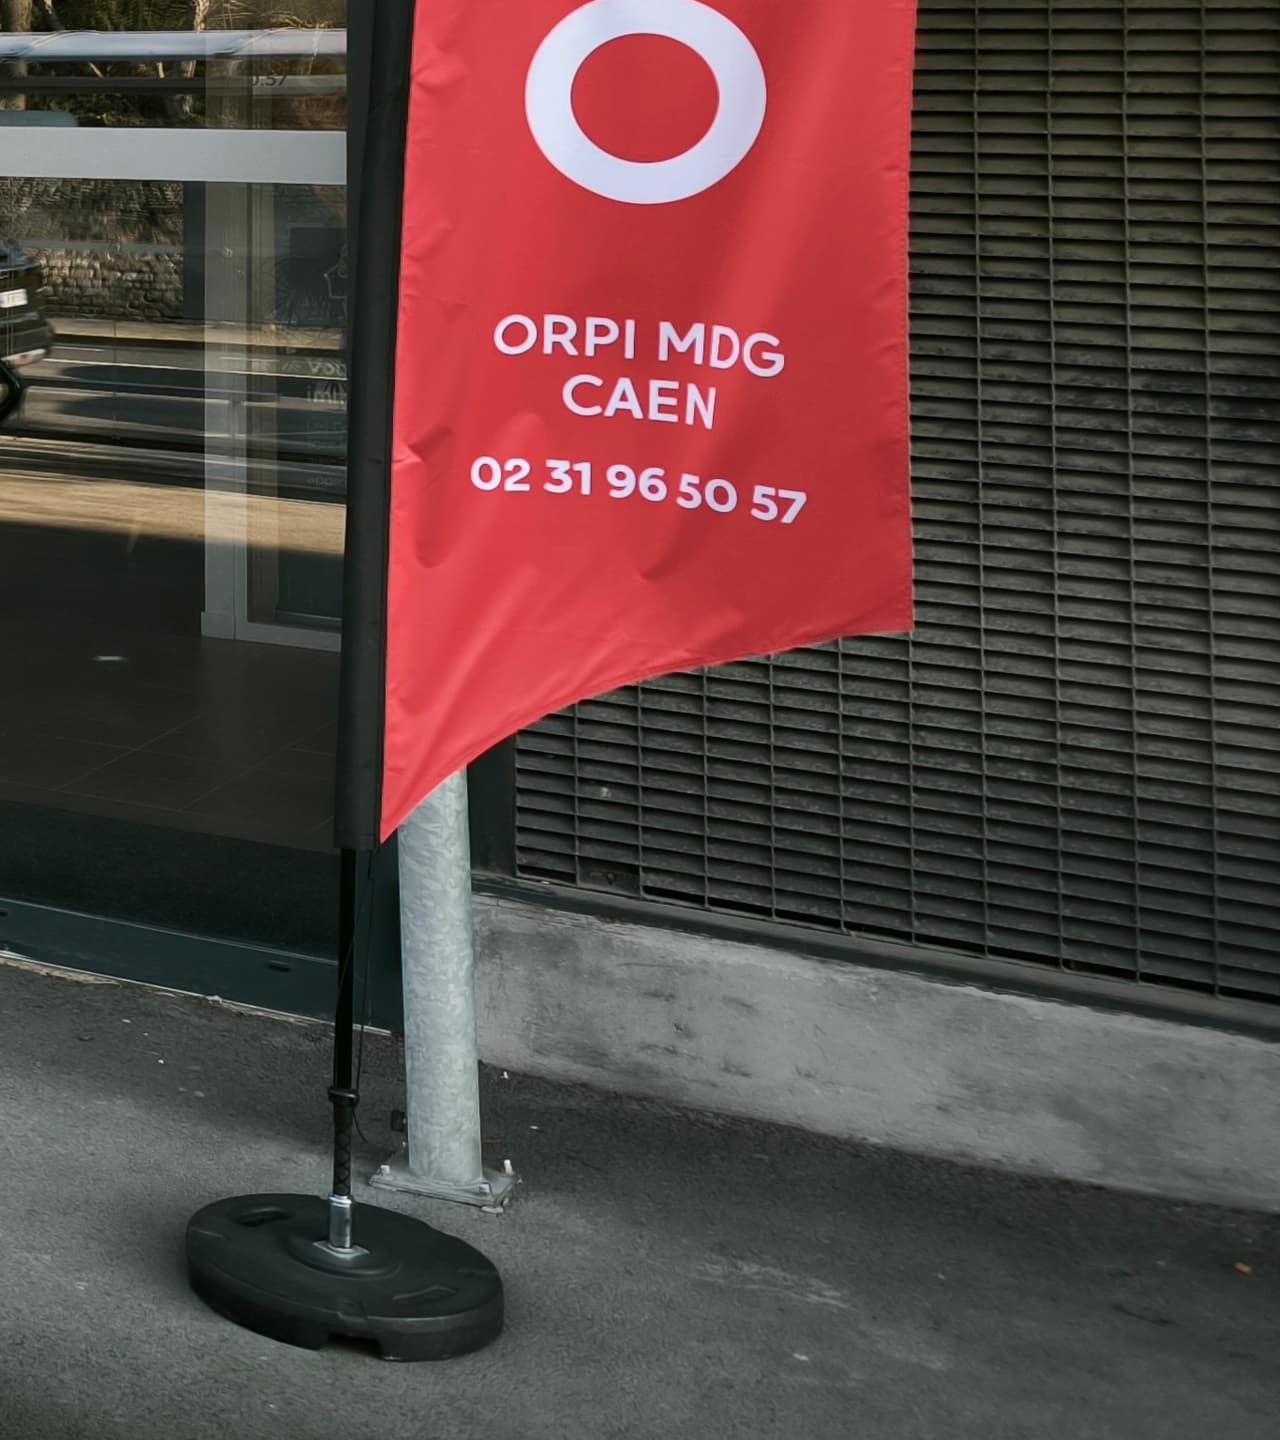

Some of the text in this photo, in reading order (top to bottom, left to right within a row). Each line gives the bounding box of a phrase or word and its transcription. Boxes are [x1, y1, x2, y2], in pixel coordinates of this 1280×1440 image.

[493, 314, 785, 377] ORPI MDG
[561, 374, 718, 429] CAEN
[470, 456, 807, 524] 02 31 96 50 57
